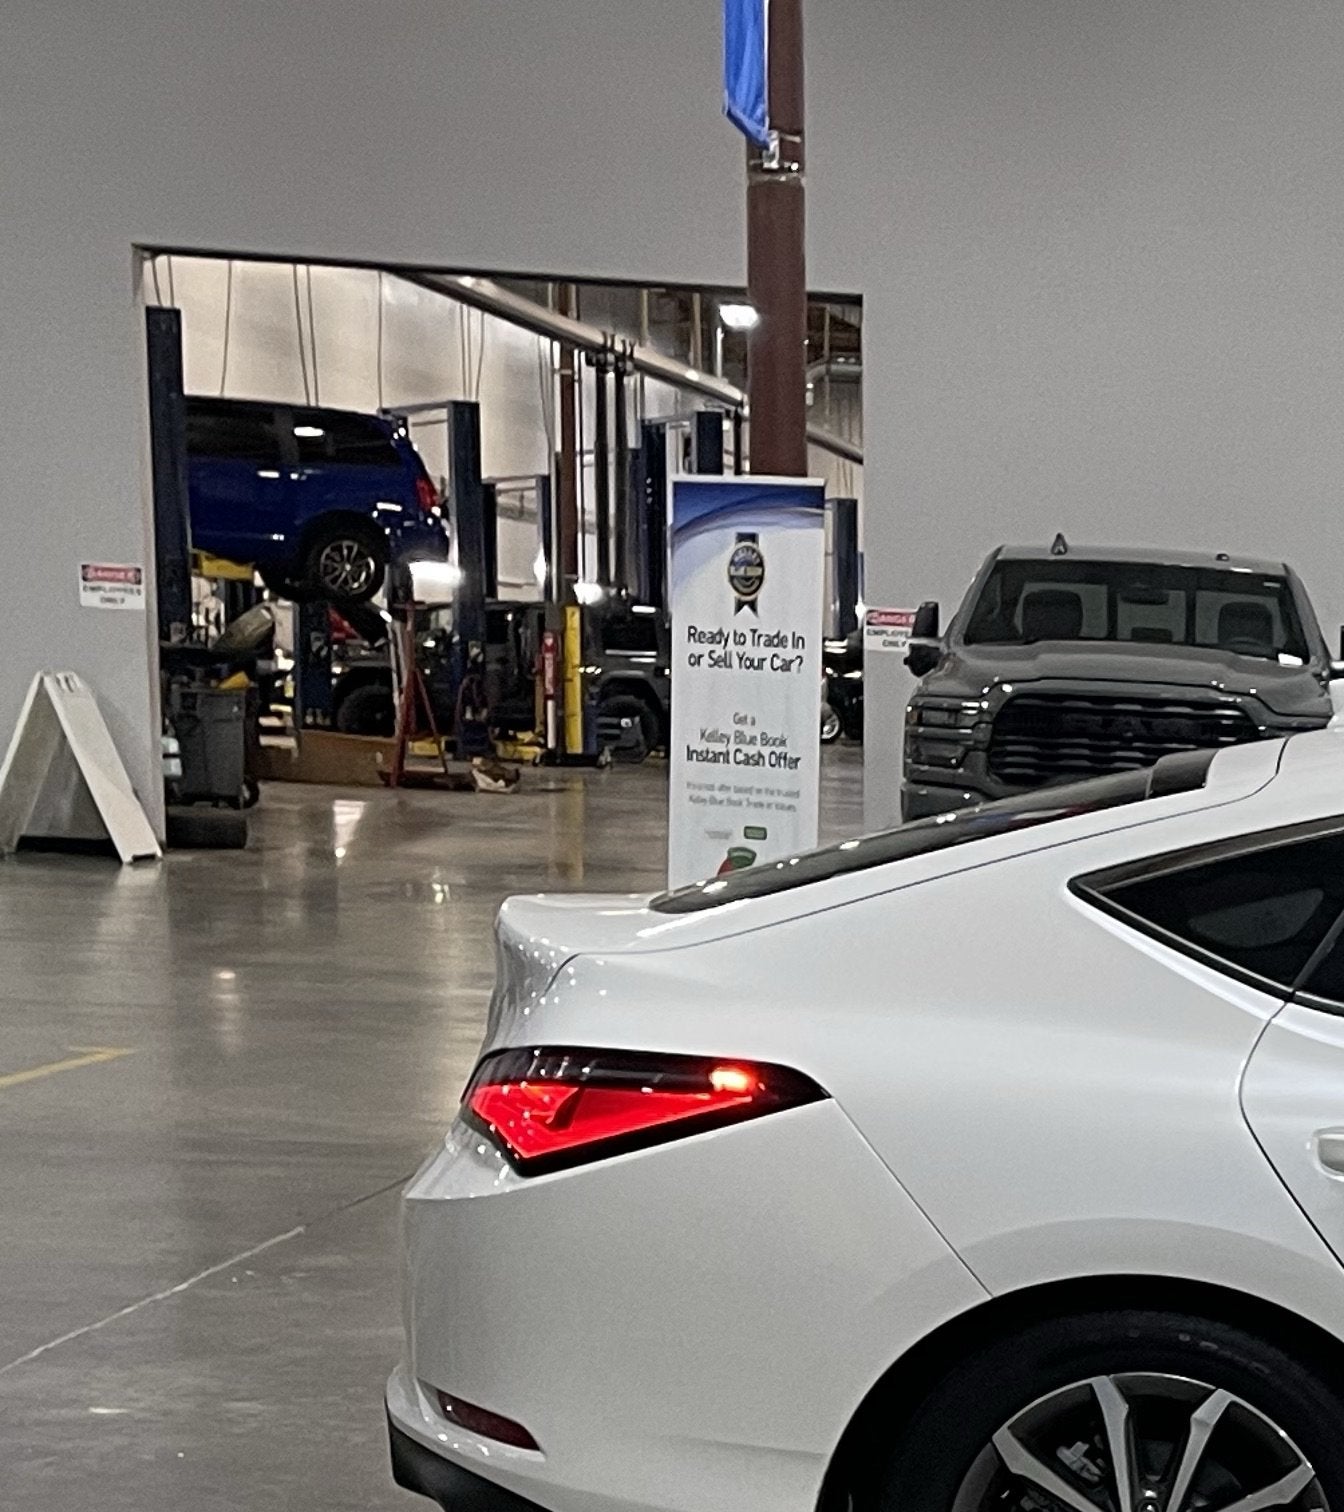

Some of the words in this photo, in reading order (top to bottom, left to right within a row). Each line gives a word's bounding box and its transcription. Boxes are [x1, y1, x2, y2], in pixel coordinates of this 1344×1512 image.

[687, 625, 730, 650] Ready
[733, 629, 747, 646] to
[750, 628, 788, 649] Trade
[792, 631, 805, 650] In
[688, 653, 704, 667] or
[708, 650, 733, 669] Sell
[736, 651, 767, 671] Your
[770, 653, 803, 674] Car?
[734, 730, 757, 746] Blue
[760, 731, 788, 748] Book
[686, 744, 730, 764] Instant
[733, 748, 765, 767] Cash
[768, 751, 801, 770] Offer
